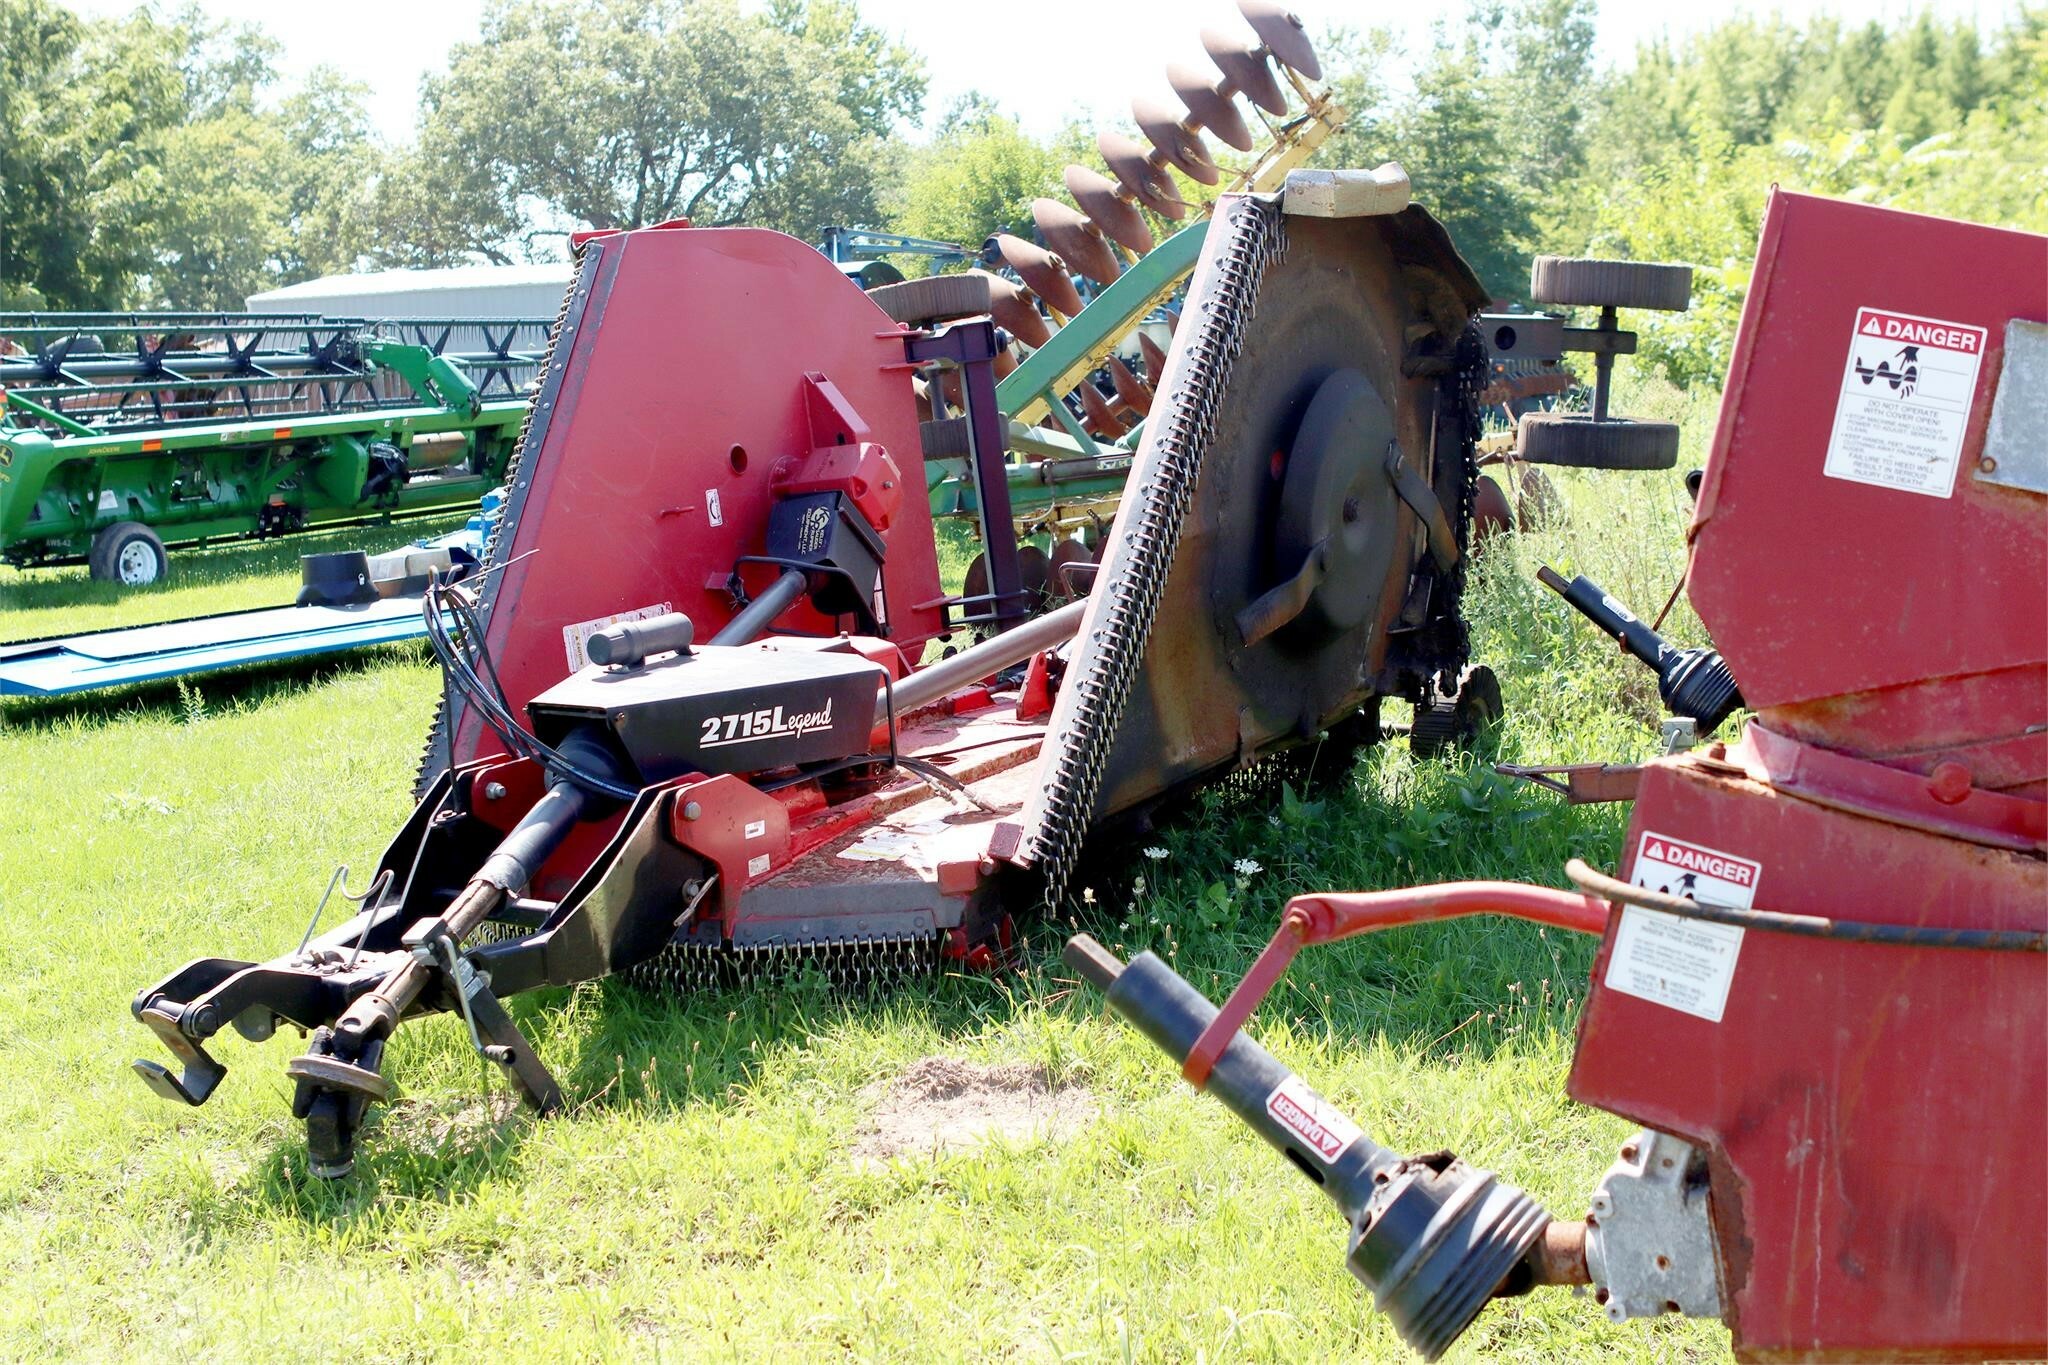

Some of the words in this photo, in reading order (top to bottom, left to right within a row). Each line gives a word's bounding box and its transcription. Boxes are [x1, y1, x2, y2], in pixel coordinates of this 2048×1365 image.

[1885, 320, 1977, 351] DANGER
[1864, 406, 1884, 416] WITH
[1885, 410, 1913, 421] COVER
[1868, 399, 1881, 407] DO
[1882, 402, 1899, 411] NOT
[1901, 406, 1938, 418] OPERATE
[1667, 846, 1752, 884] DANGER
[1274, 1096, 1323, 1141] DANGER
